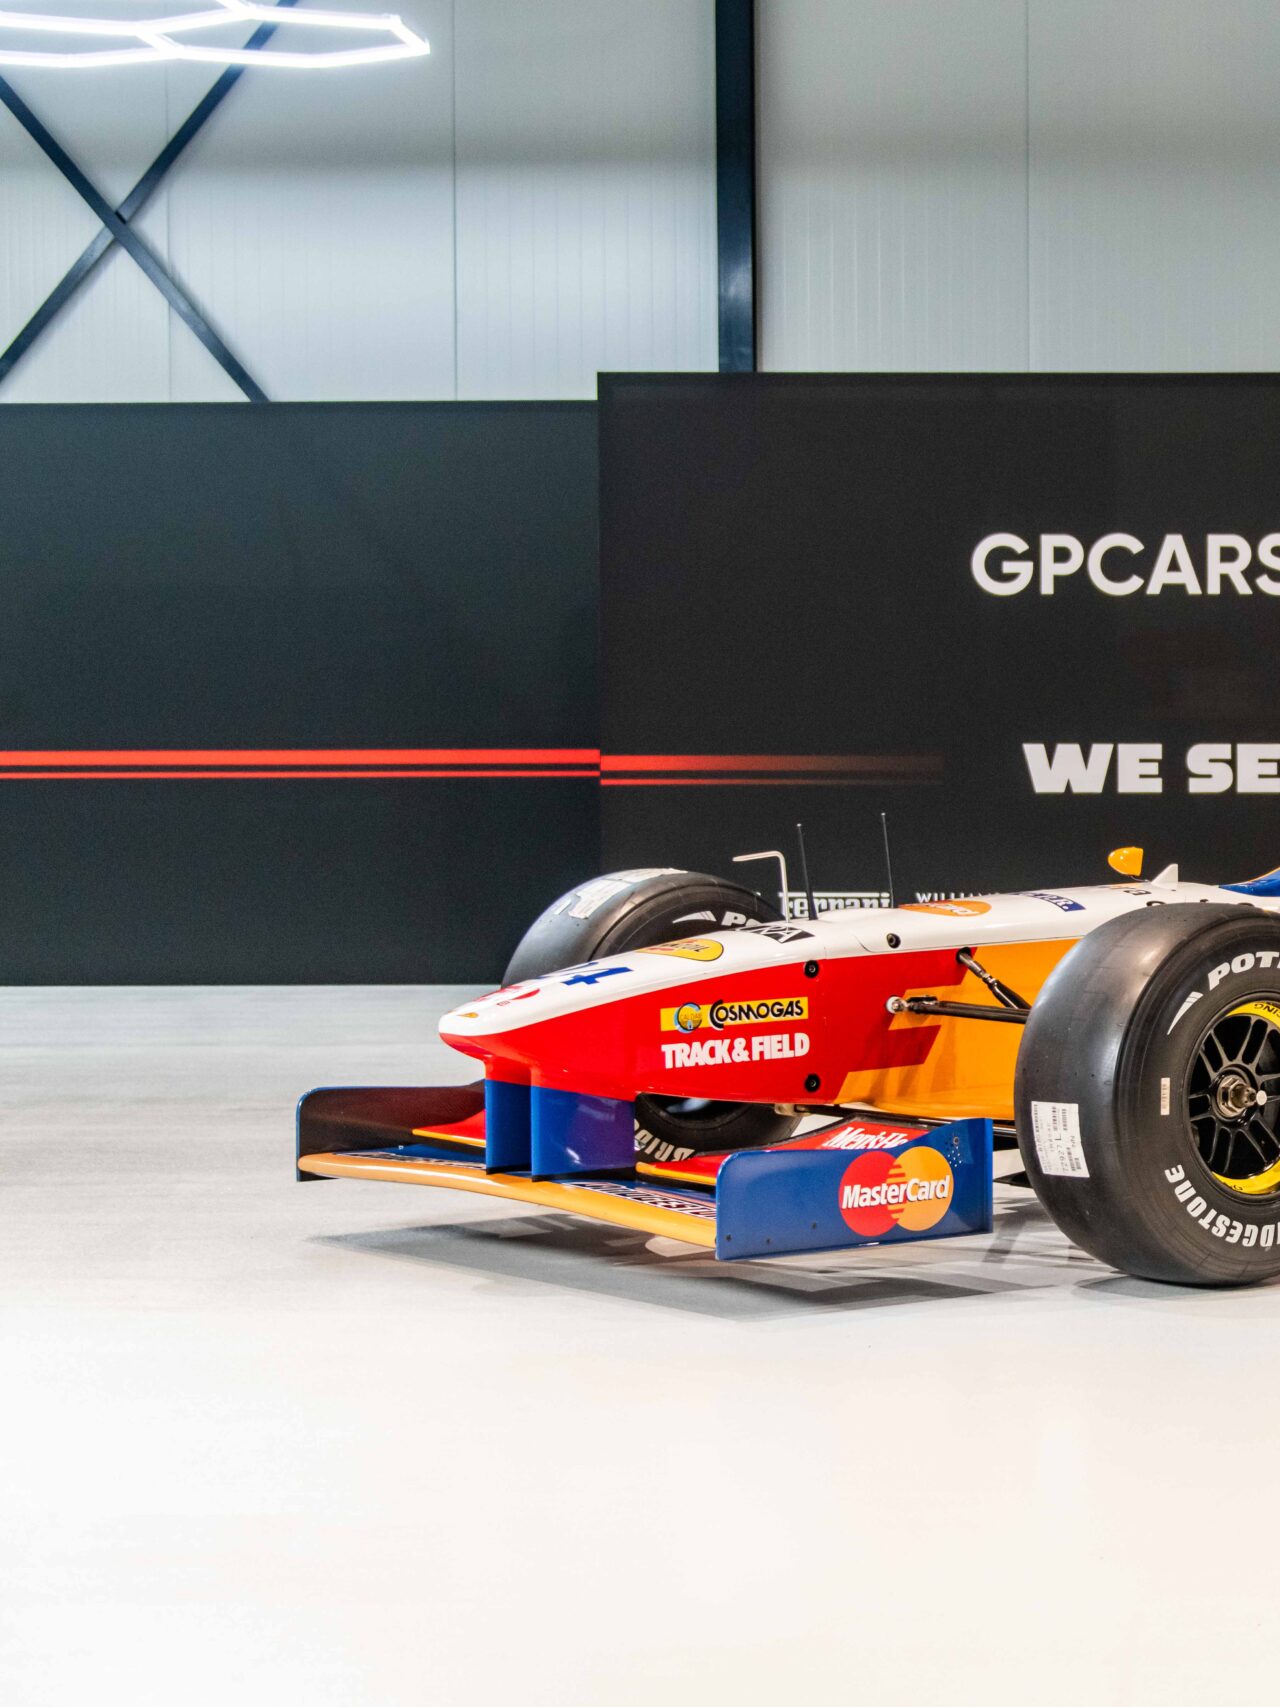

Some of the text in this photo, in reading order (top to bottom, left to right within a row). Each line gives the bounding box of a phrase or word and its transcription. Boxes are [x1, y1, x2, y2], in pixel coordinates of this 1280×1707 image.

[1022, 743, 1163, 793] WE
[709, 999, 804, 1030] COSMOGAS
[841, 1175, 951, 1209] MasterCard
